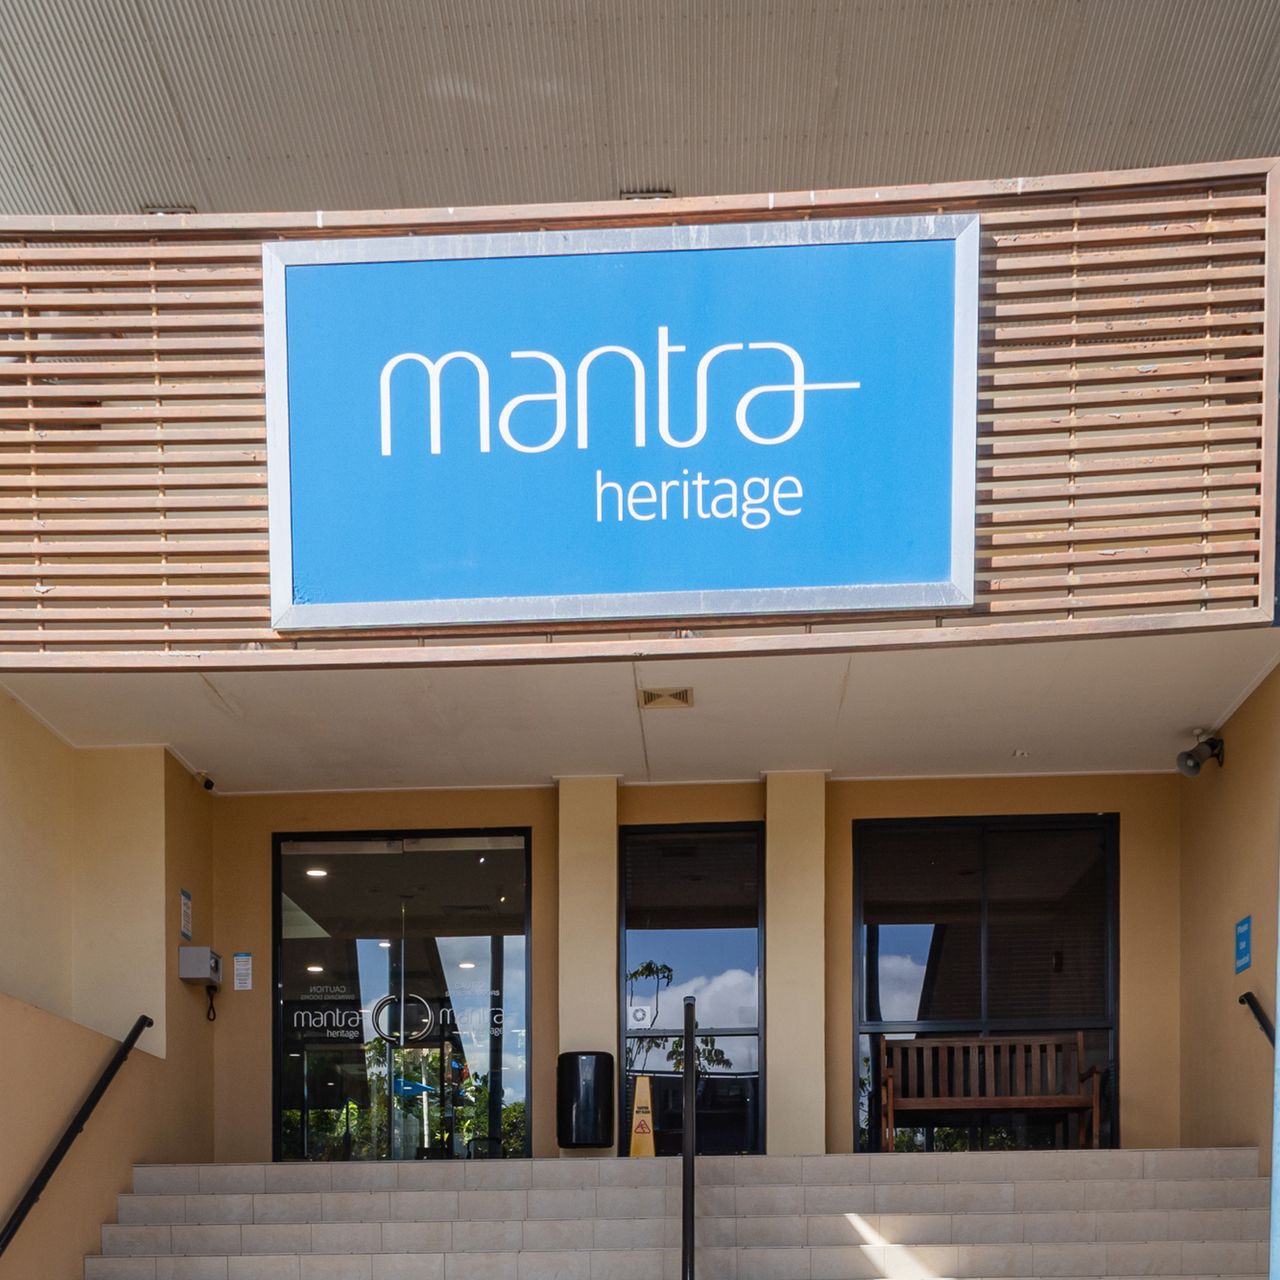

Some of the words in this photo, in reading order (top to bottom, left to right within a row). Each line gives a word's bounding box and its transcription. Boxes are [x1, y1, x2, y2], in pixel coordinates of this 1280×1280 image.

[380, 325, 861, 456] mantra
[596, 468, 804, 530] heritage
[293, 1007, 365, 1028] mantra
[326, 1029, 360, 1039] heritage
